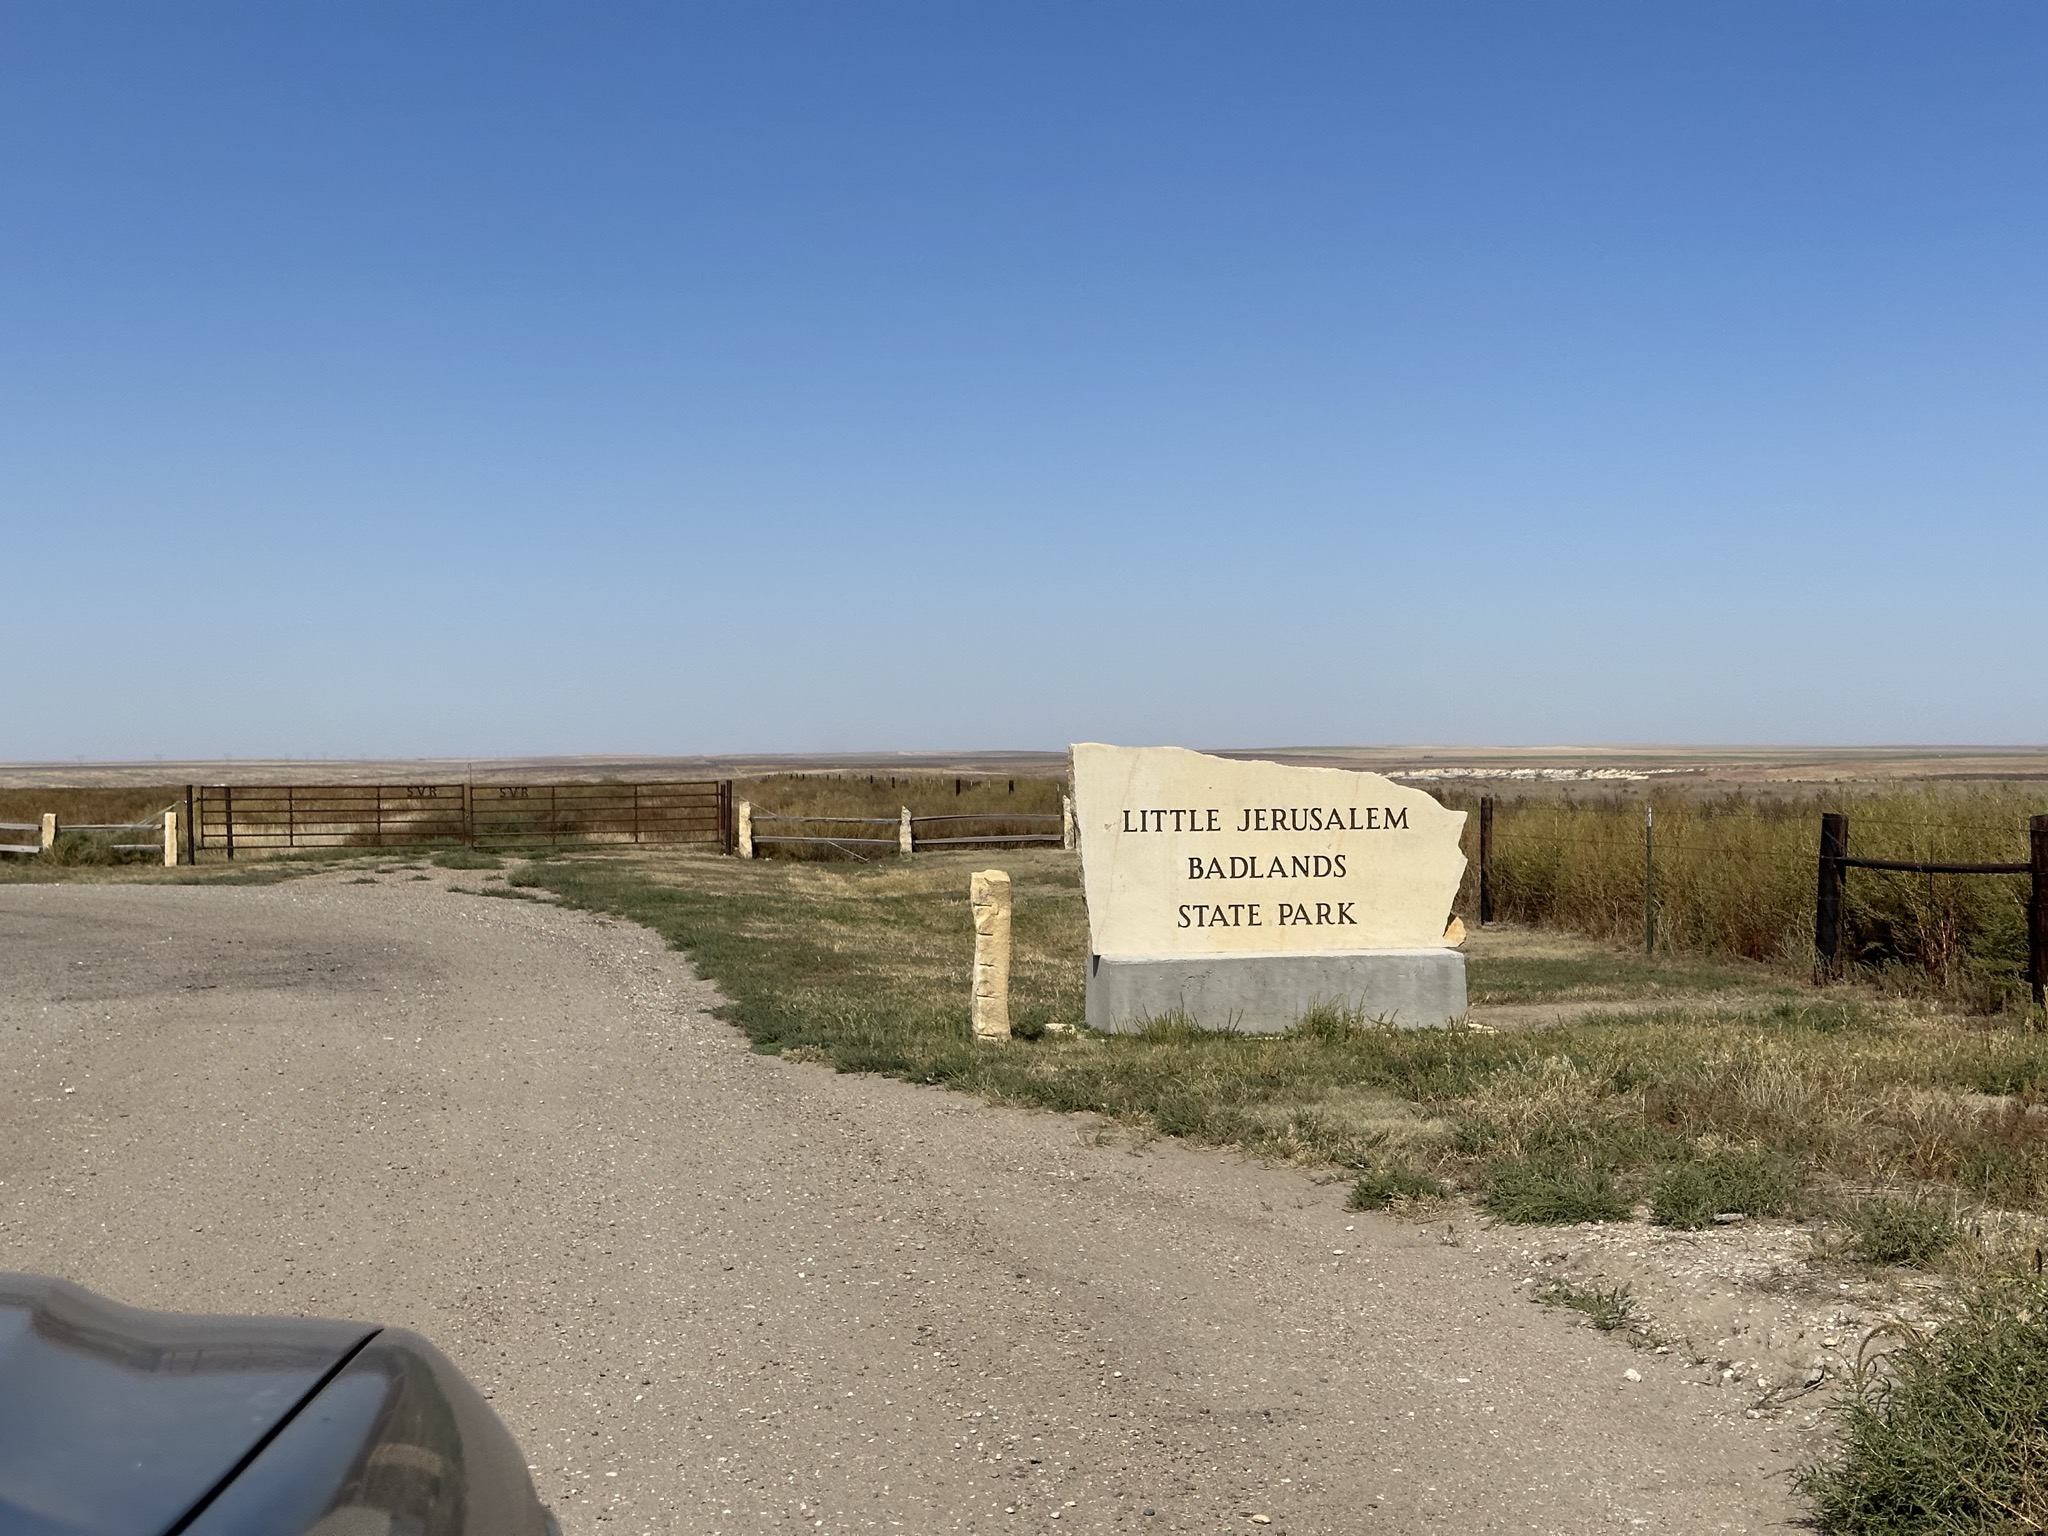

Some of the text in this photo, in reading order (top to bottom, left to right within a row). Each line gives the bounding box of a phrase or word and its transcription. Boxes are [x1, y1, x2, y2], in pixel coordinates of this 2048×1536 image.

[1122, 807, 1409, 833] LITTLE JERUSALEM
[1188, 854, 1347, 880] BADLANDS
[1177, 902, 1358, 929] STATE PARK
